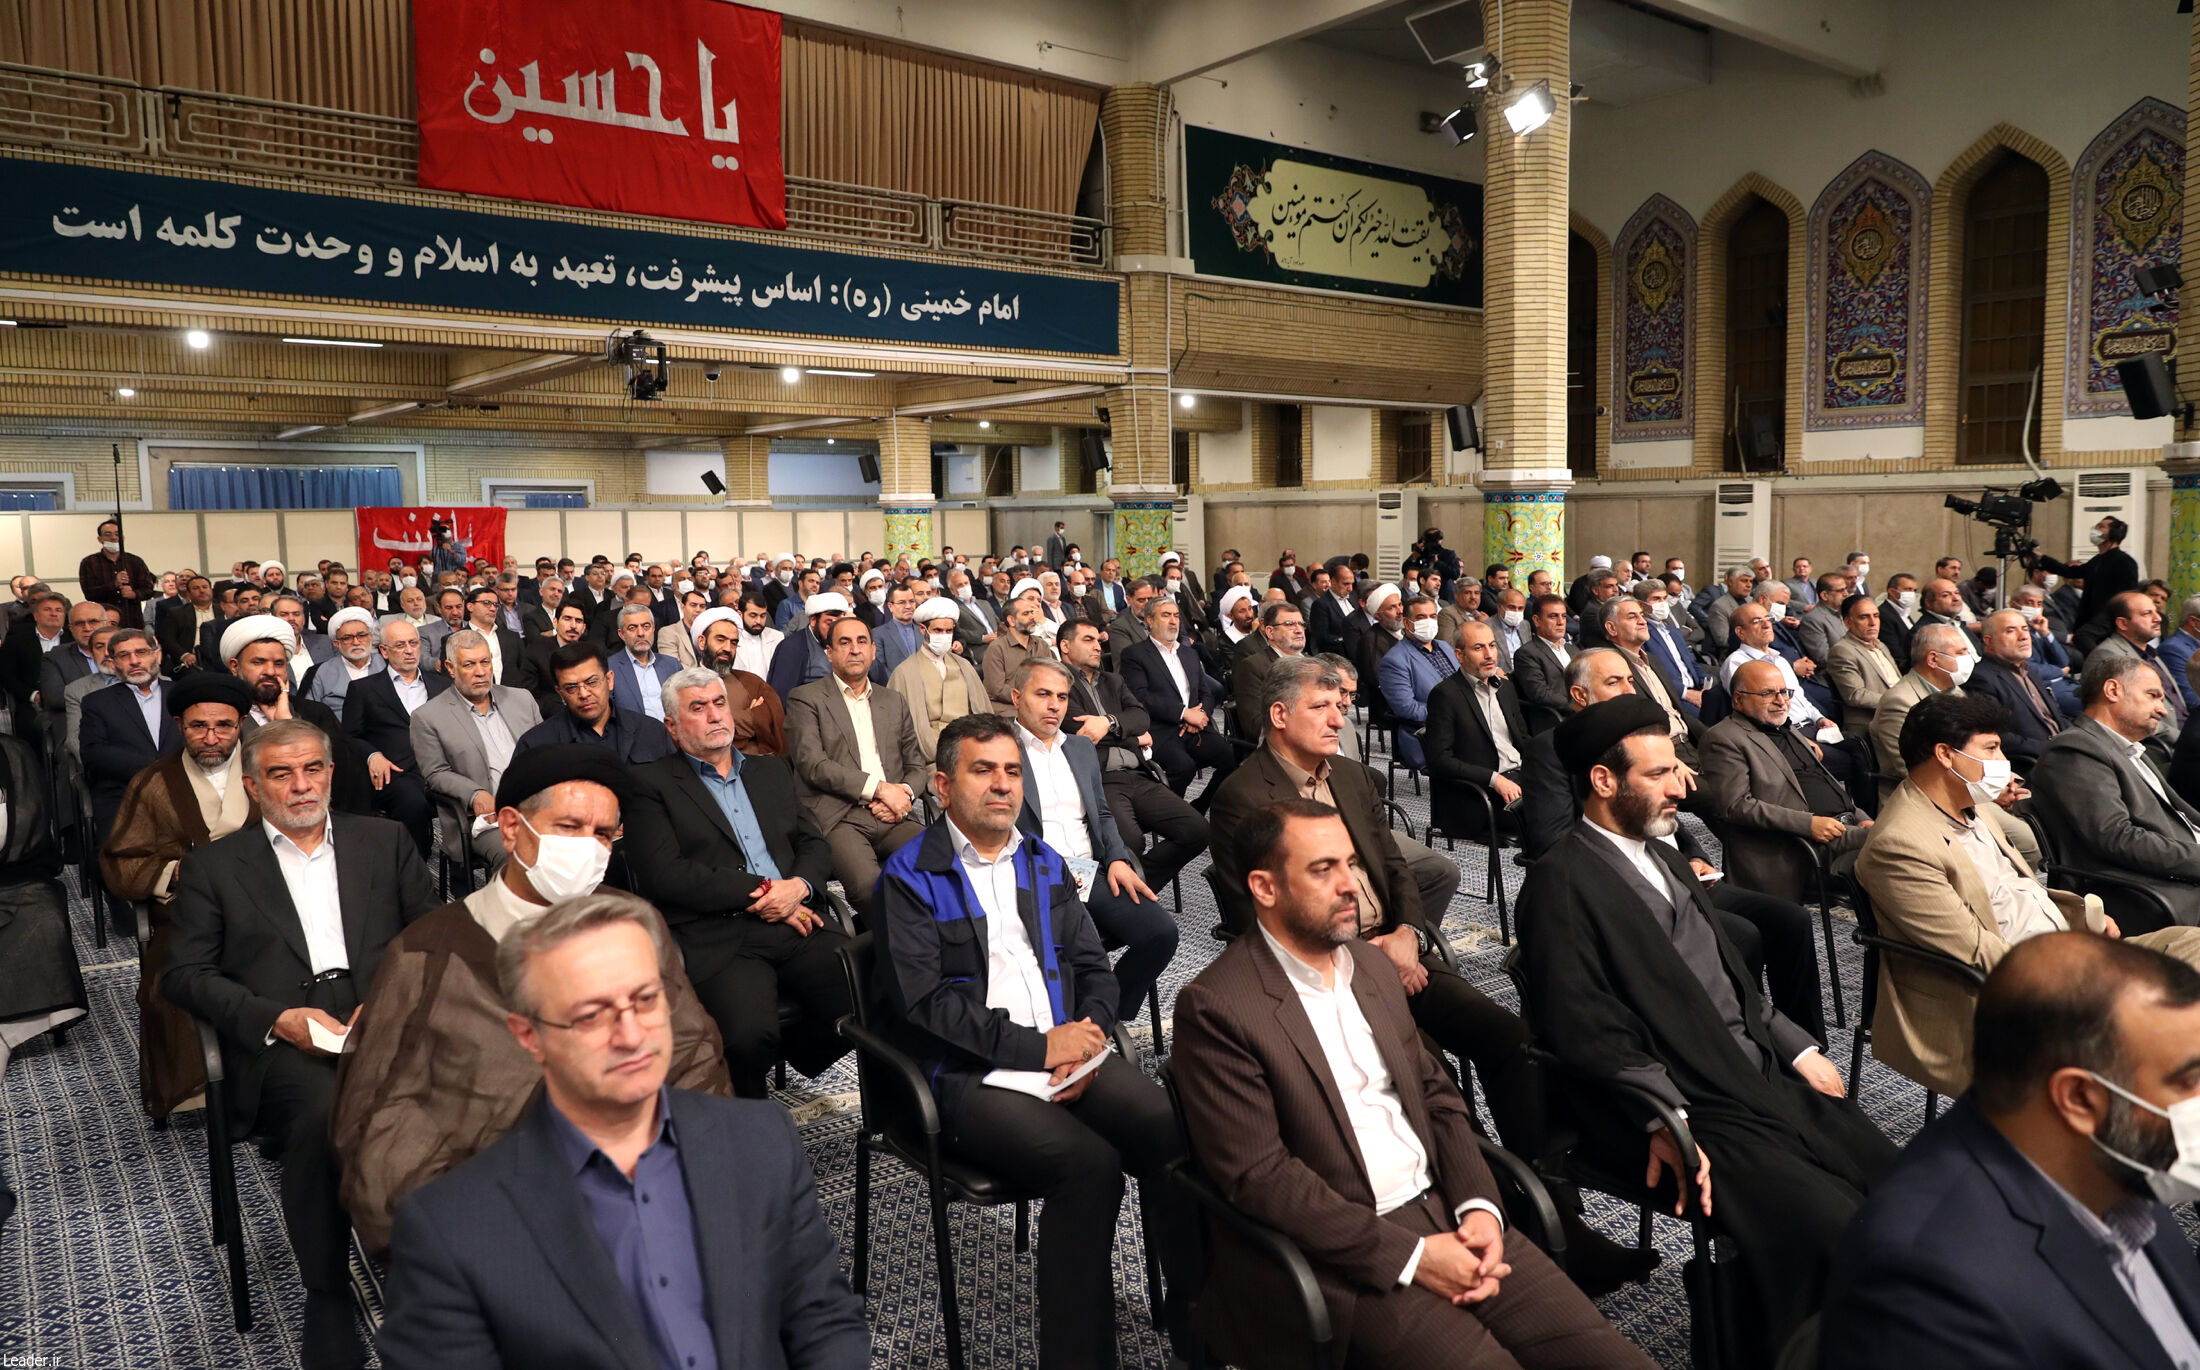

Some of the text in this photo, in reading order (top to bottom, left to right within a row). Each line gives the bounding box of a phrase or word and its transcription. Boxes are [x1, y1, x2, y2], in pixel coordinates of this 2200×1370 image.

[463, 37, 740, 171] یا حسین
[53, 204, 142, 242] است
[156, 212, 242, 249] کلمه
[256, 227, 373, 275] وحدت
[384, 247, 404, 277] و
[414, 235, 499, 279] اسلام
[511, 251, 538, 287] به
[552, 254, 617, 289] تعهد
[752, 272, 822, 308] اساس
[900, 289, 972, 322] خمینی
[979, 293, 1019, 326] امام
